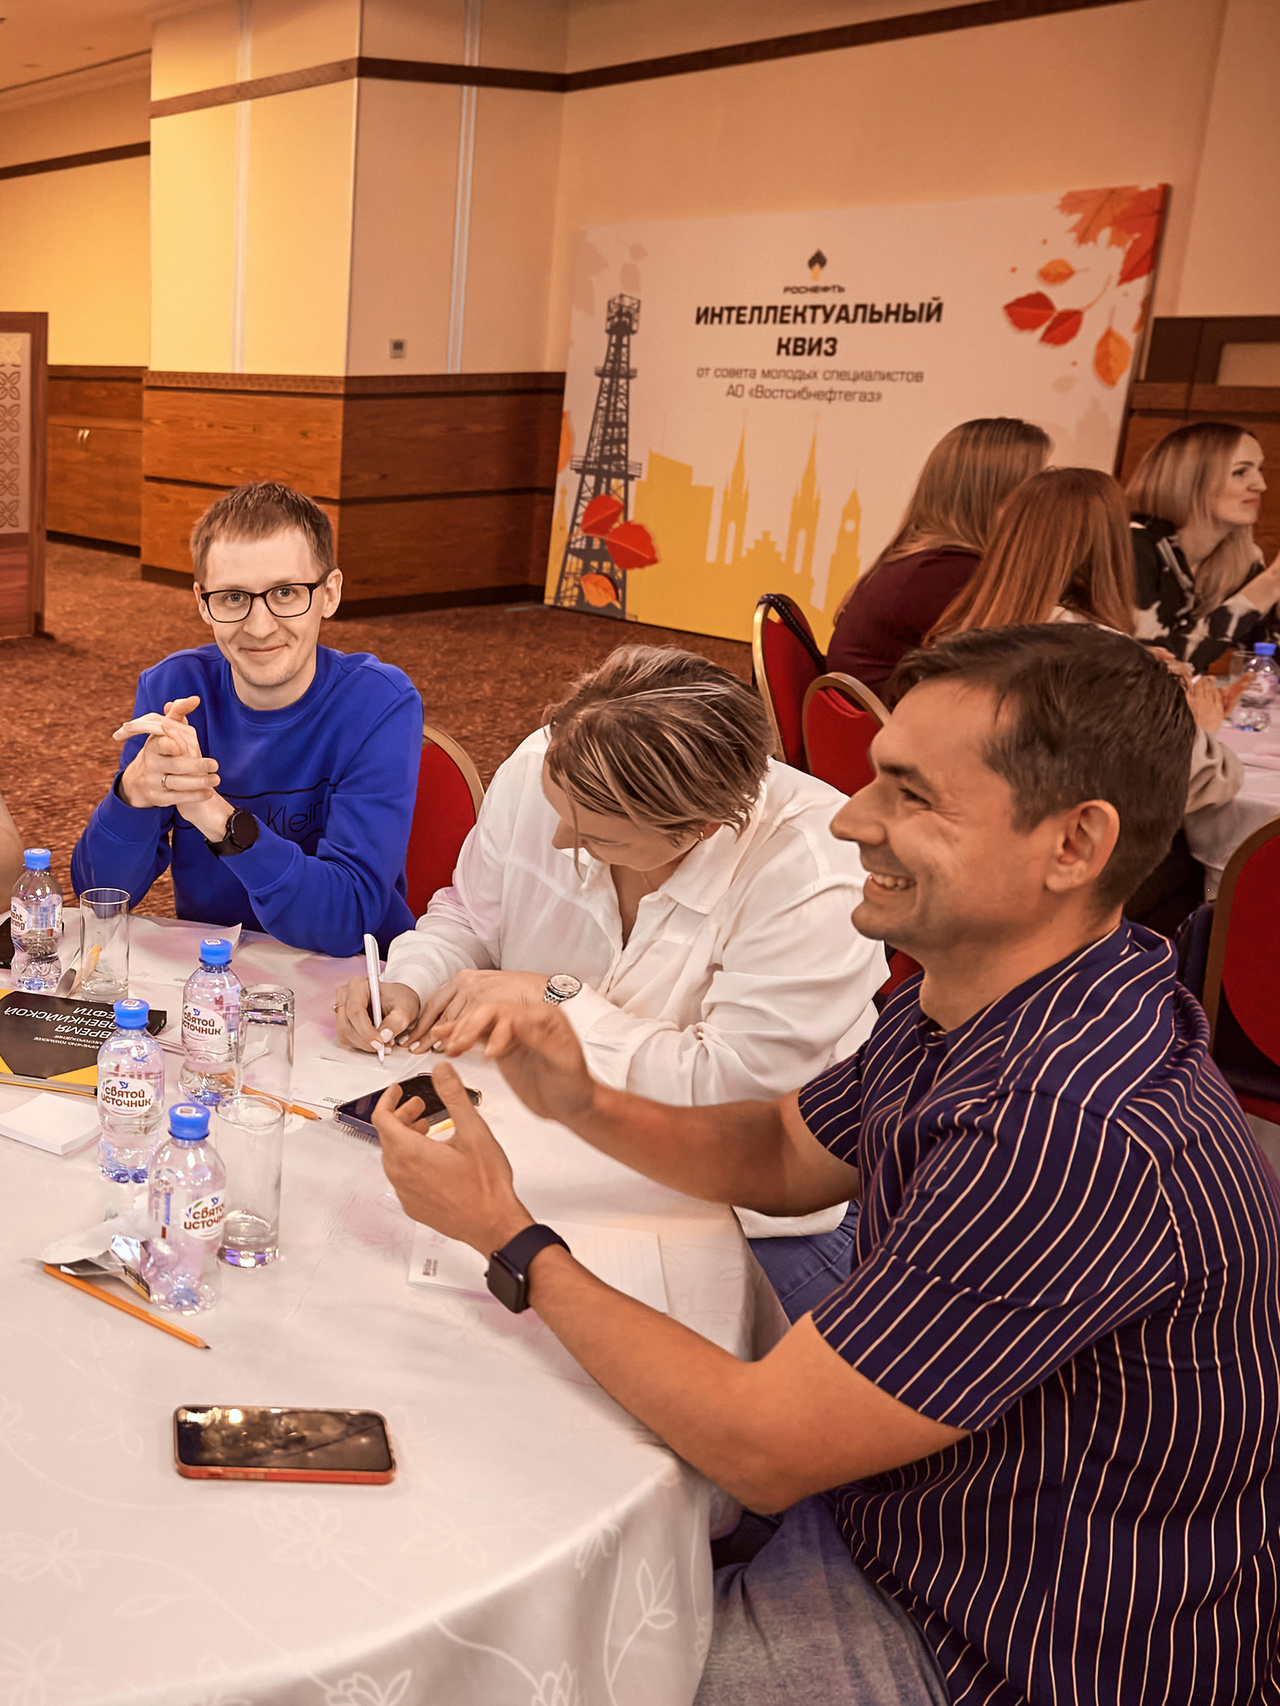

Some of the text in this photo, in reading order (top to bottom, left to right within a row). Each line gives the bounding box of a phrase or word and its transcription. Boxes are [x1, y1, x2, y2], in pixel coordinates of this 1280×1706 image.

[783, 285, 846, 294] РОСНЕФТЬ
[695, 296, 944, 325] ИНТЕЛЛЕКТУАЛЬНЫЙ
[776, 336, 838, 357] КВИЗ
[697, 367, 924, 383] от совета молодых специалистов
[726, 384, 883, 404] АО «Востсибнефтегаз»
[4, 1006, 118, 1030] ЭВЕНКИЙСКОЙ
[73, 1006, 116, 1019] ЕФТИ
[55, 1024, 112, 1039] ВРЕМЯ
